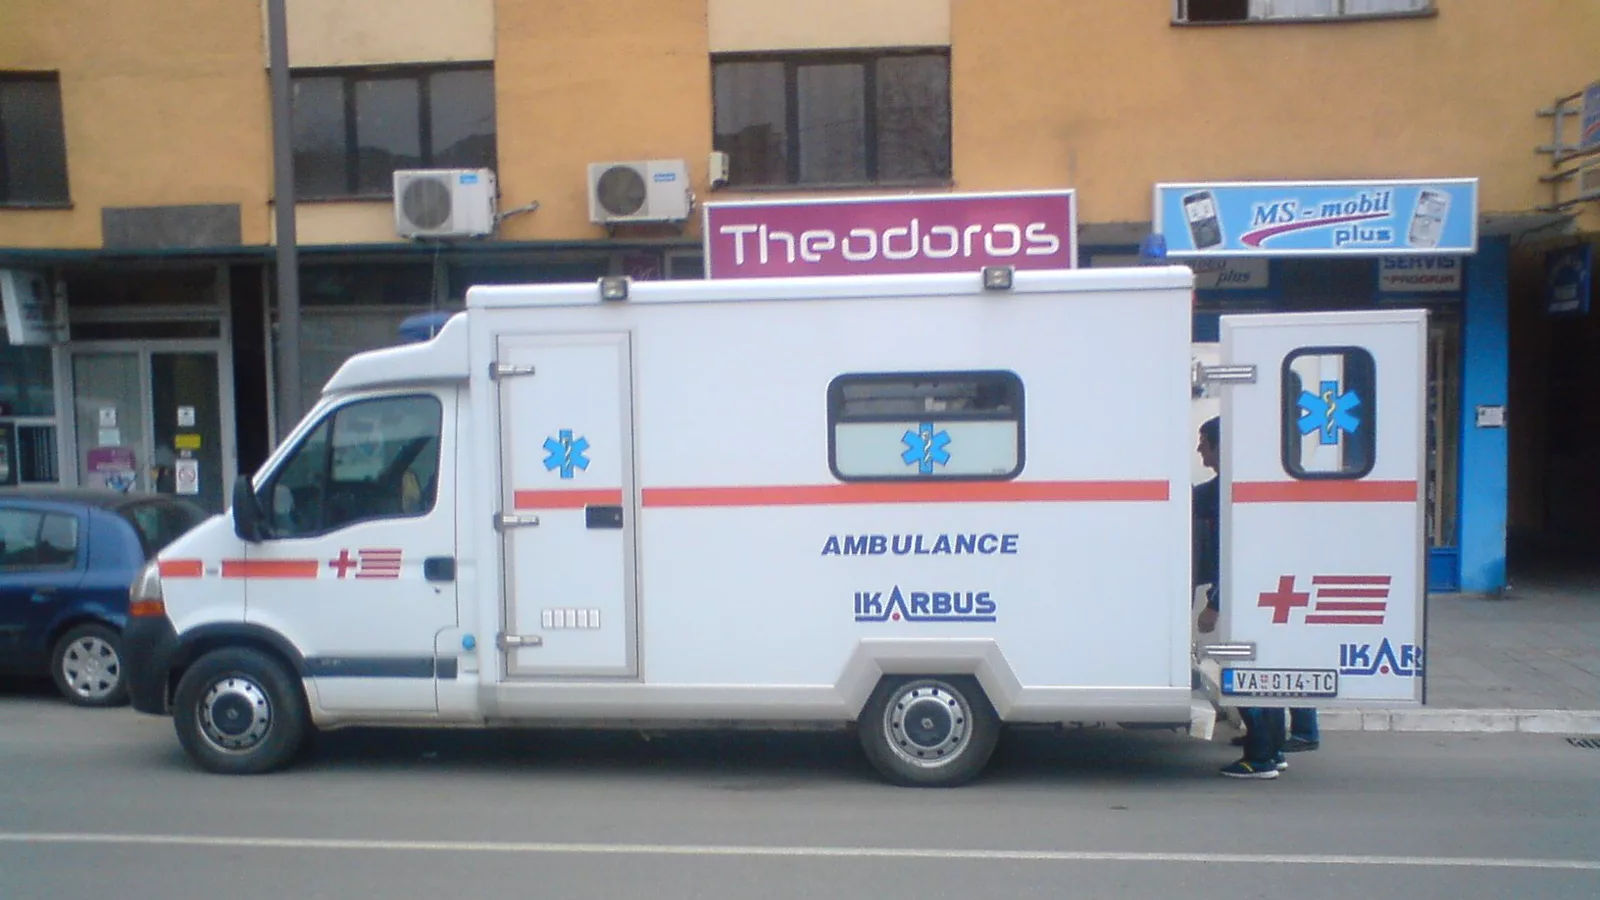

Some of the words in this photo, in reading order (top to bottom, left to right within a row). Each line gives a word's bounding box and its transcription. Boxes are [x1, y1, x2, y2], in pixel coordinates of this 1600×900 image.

[1254, 202, 1295, 225] MS
[1320, 191, 1390, 217] mobil
[719, 218, 1060, 265] Theodoros
[1336, 225, 1392, 246] plus
[821, 533, 1019, 556] AMBULANCE
[854, 585, 997, 622] IKARBUS
[1236, 673, 1258, 690] VA
